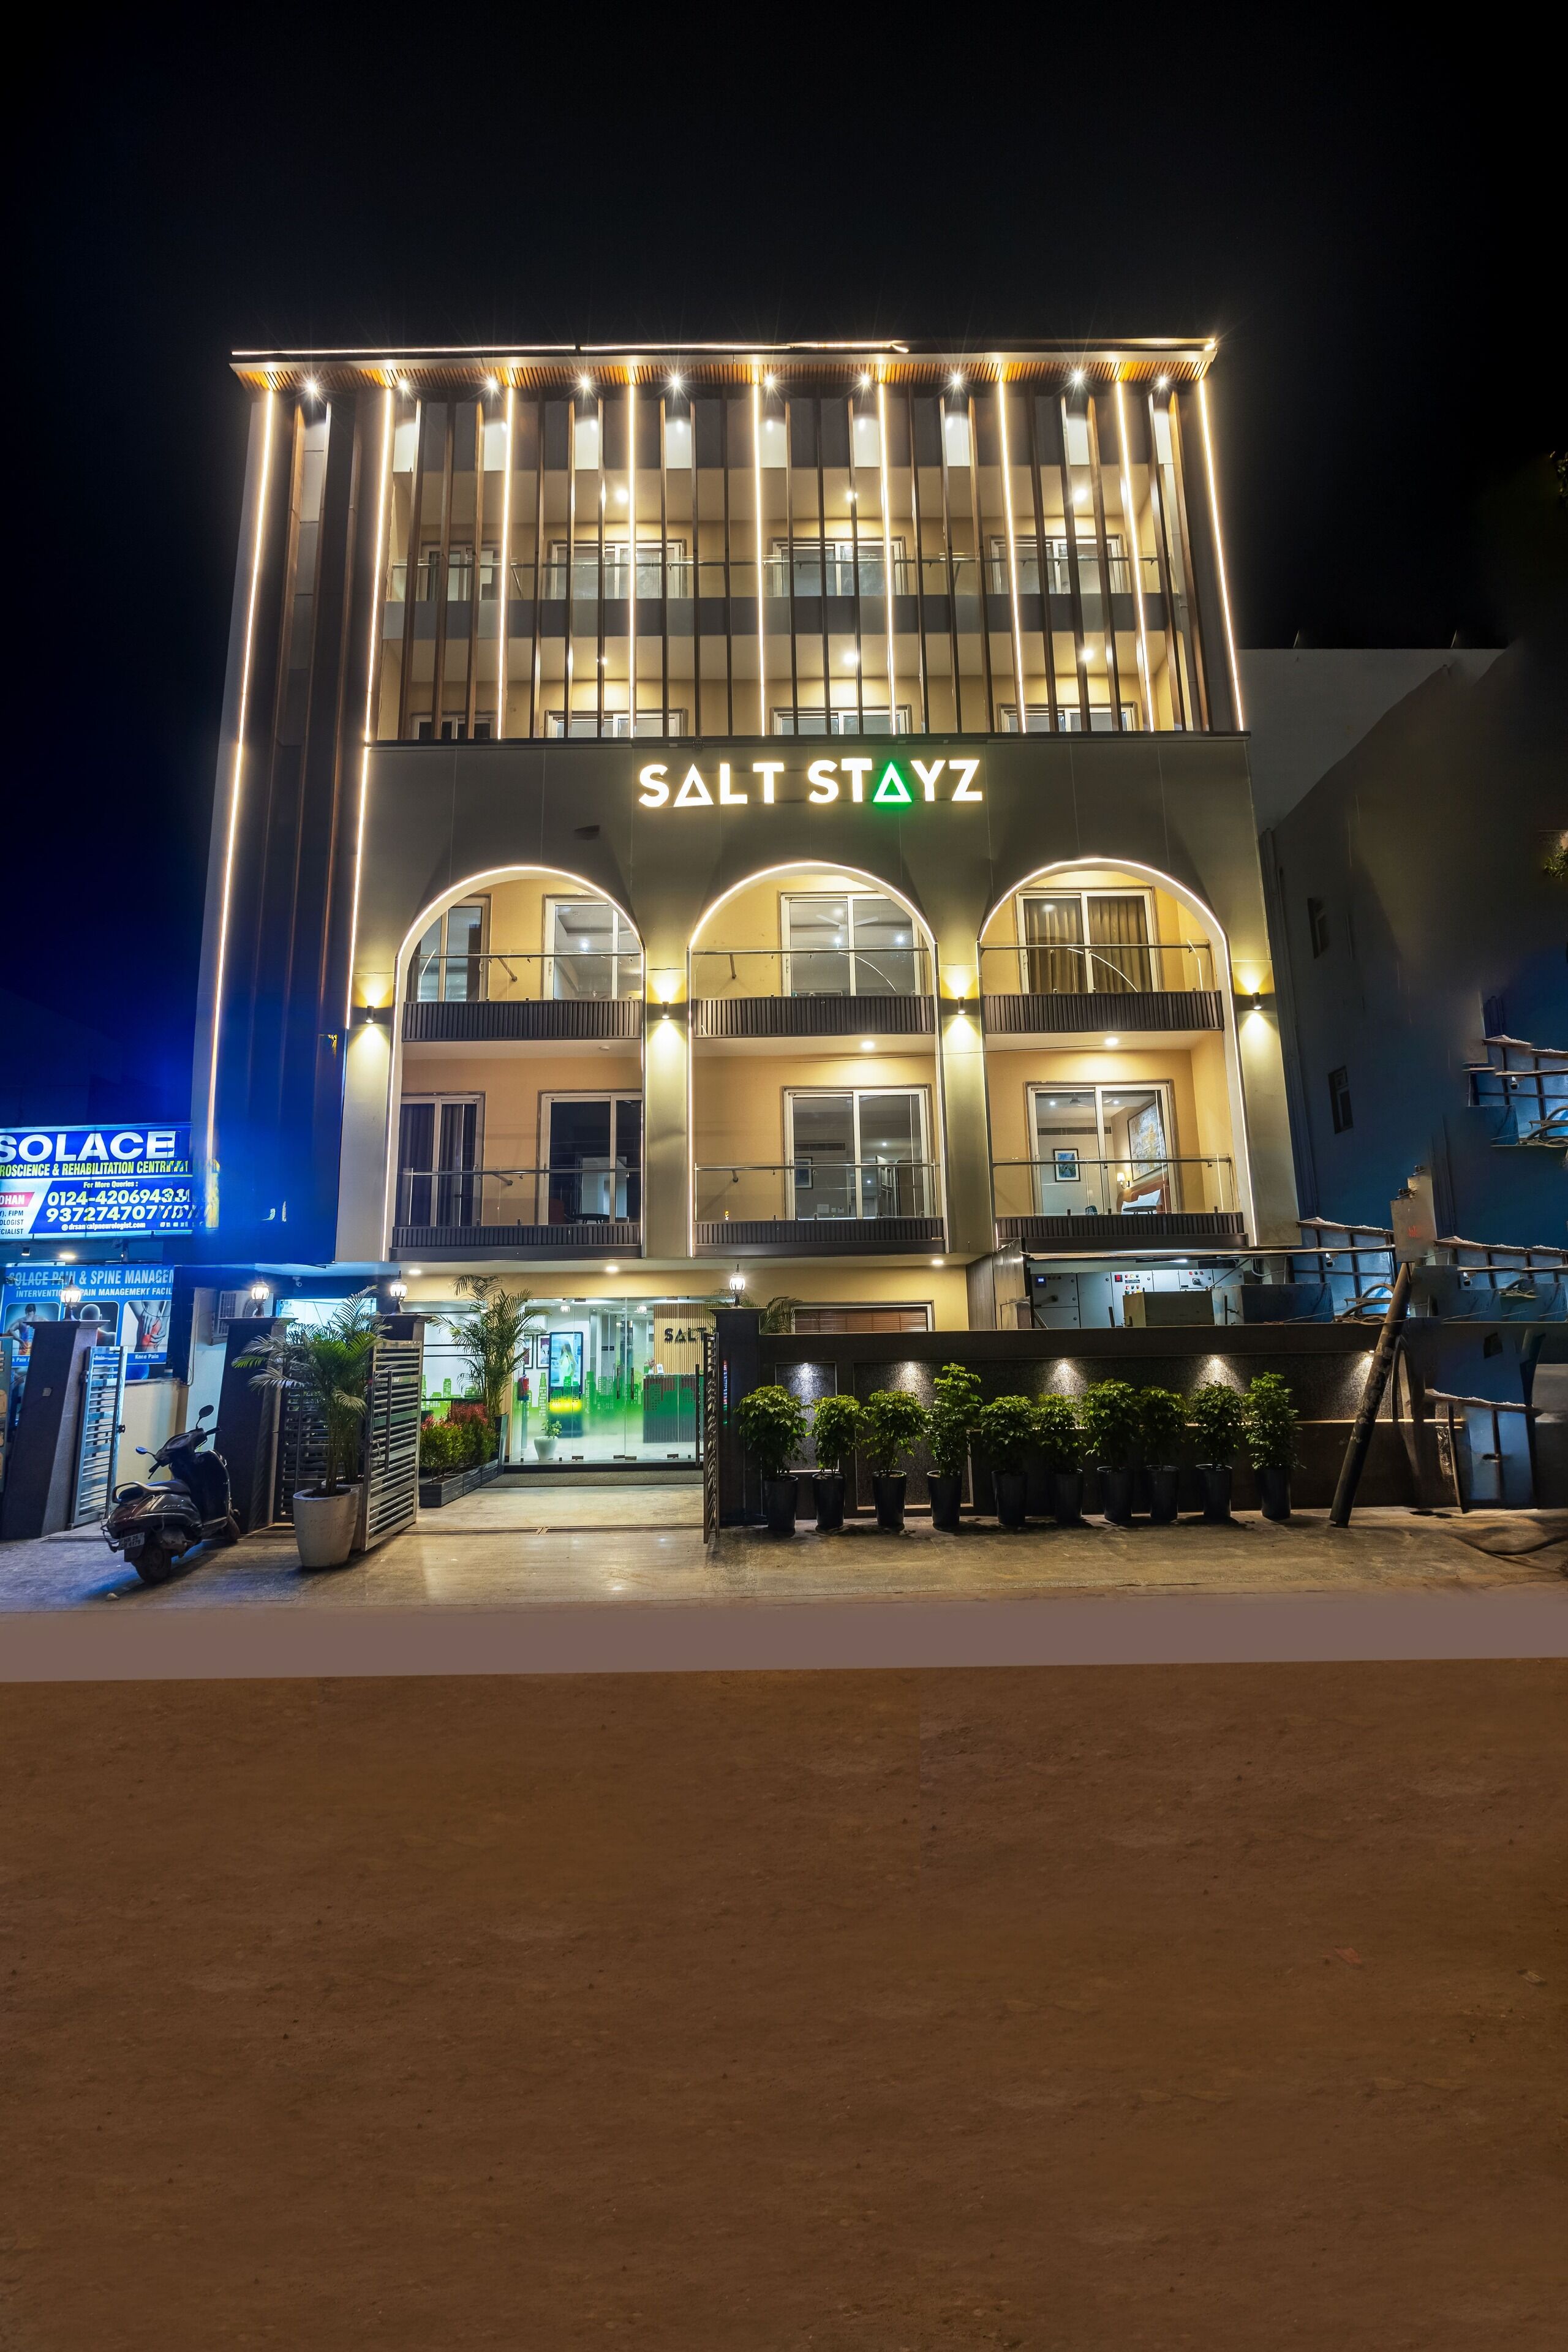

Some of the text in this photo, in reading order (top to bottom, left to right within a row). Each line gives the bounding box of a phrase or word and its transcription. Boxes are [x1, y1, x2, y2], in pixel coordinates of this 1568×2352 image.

[638, 758, 982, 807] SALT STAYZ
[0, 1131, 175, 1163] SOLACE
[52, 1163, 59, 1175] &
[62, 1161, 134, 1175] REHABILITATION
[9, 1272, 49, 1286] SOLACE
[51, 1271, 76, 1285] PAIN
[79, 1270, 86, 1284] &
[91, 1270, 122, 1284] SPINE
[665, 1328, 706, 1343] SALT
